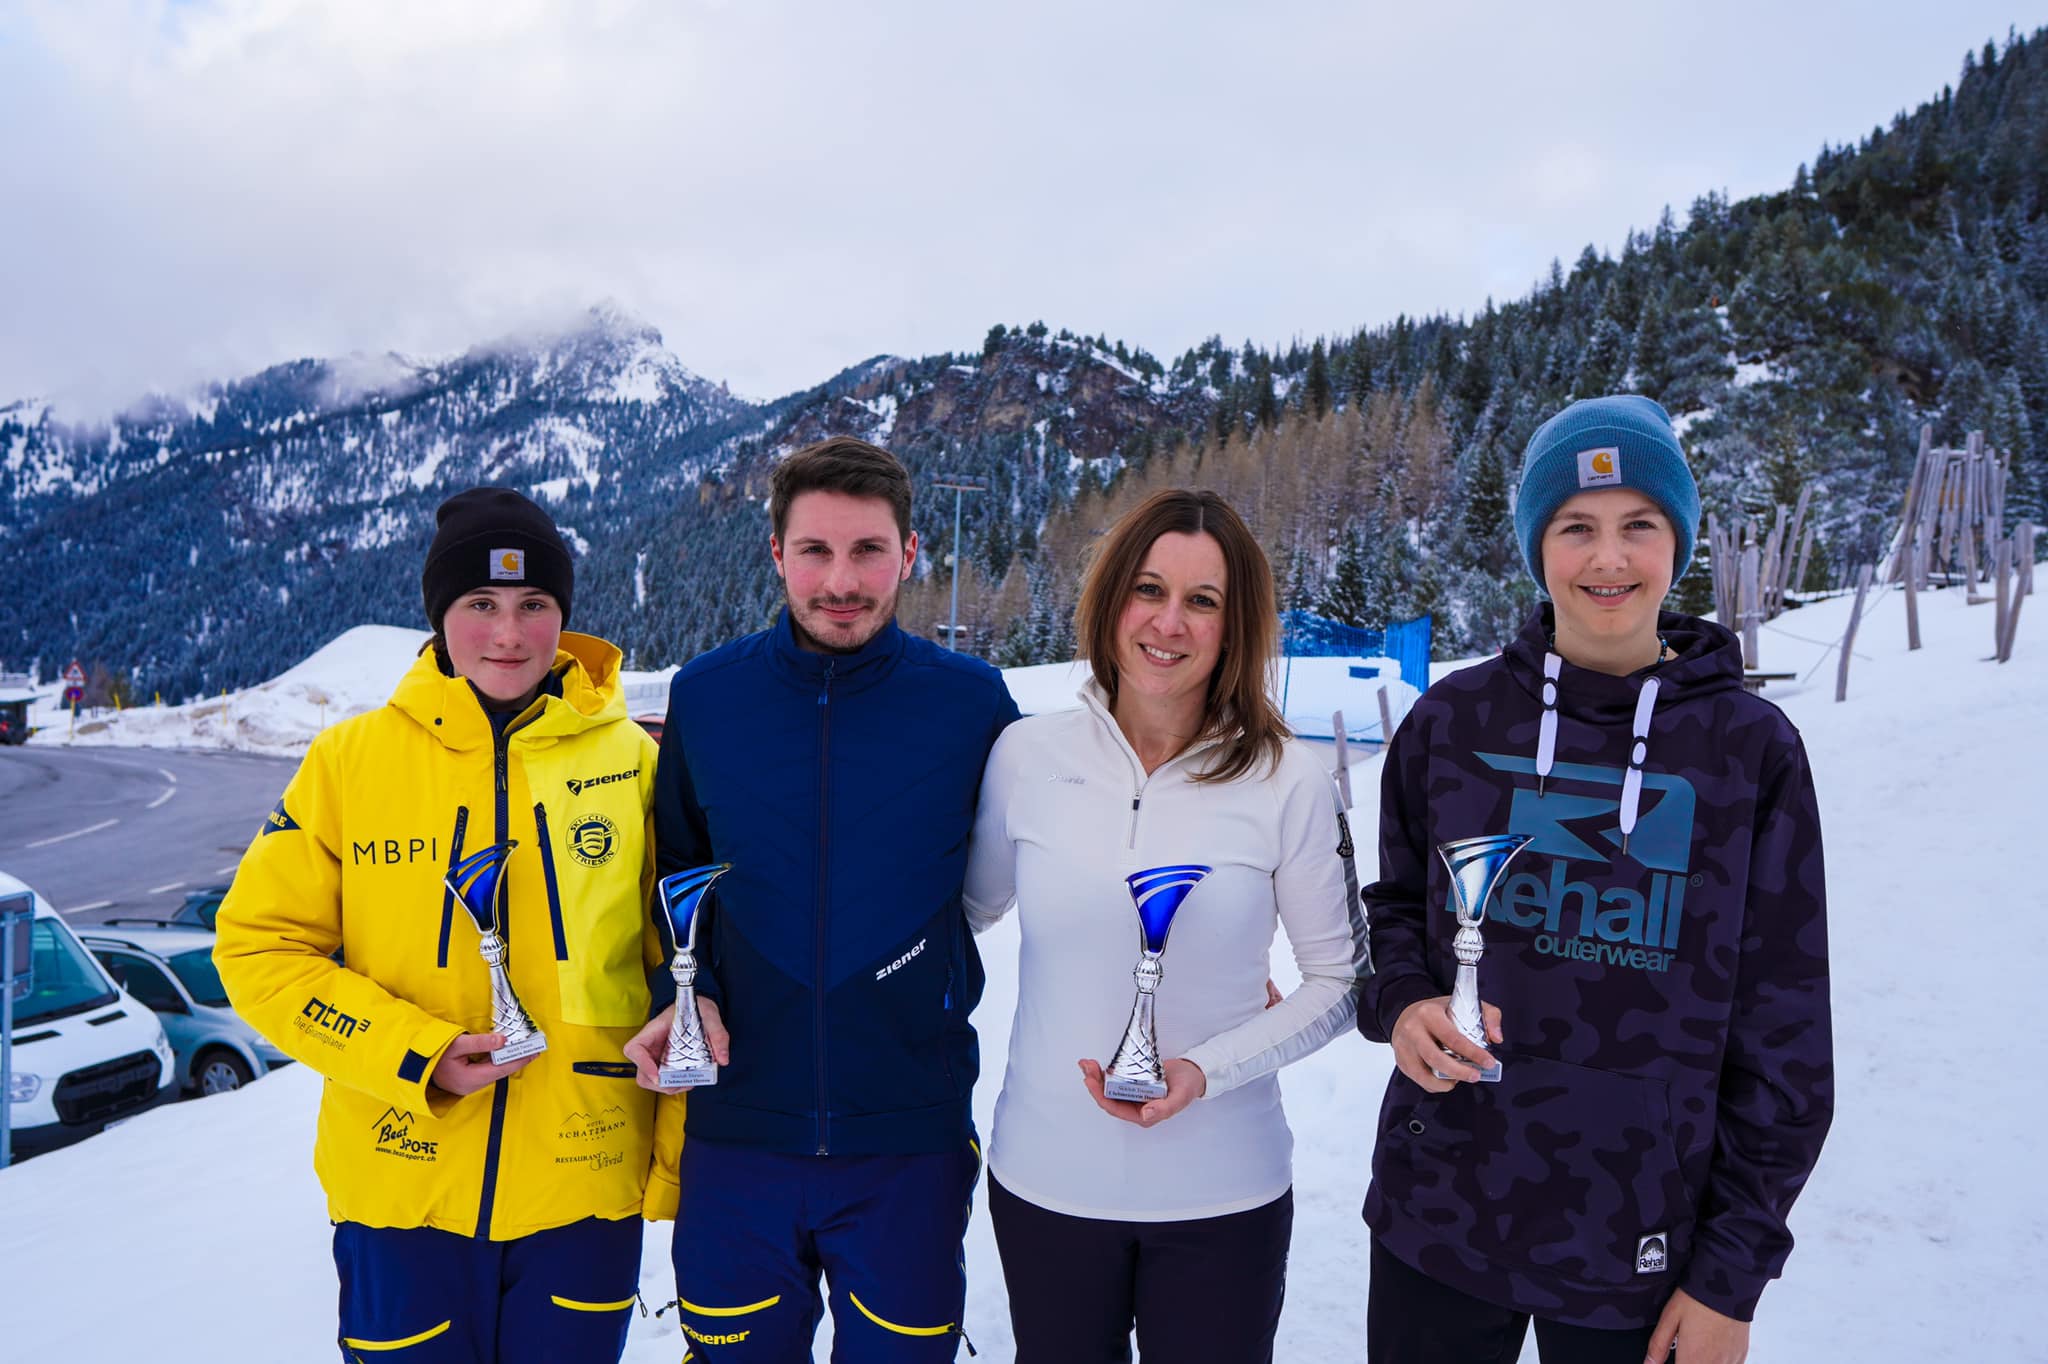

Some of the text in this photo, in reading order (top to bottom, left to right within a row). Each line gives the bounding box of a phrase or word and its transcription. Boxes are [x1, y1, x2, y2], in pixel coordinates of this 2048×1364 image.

[583, 769, 641, 789] ziener
[570, 814, 613, 832] SKI-CLUB
[353, 838, 437, 865] MBPI
[575, 851, 615, 866] TRIESEN
[876, 938, 927, 980] ziener
[1535, 934, 1676, 972] outerwear
[559, 1120, 626, 1139] SCHATZMANN
[555, 1152, 601, 1164] RESTAURANT
